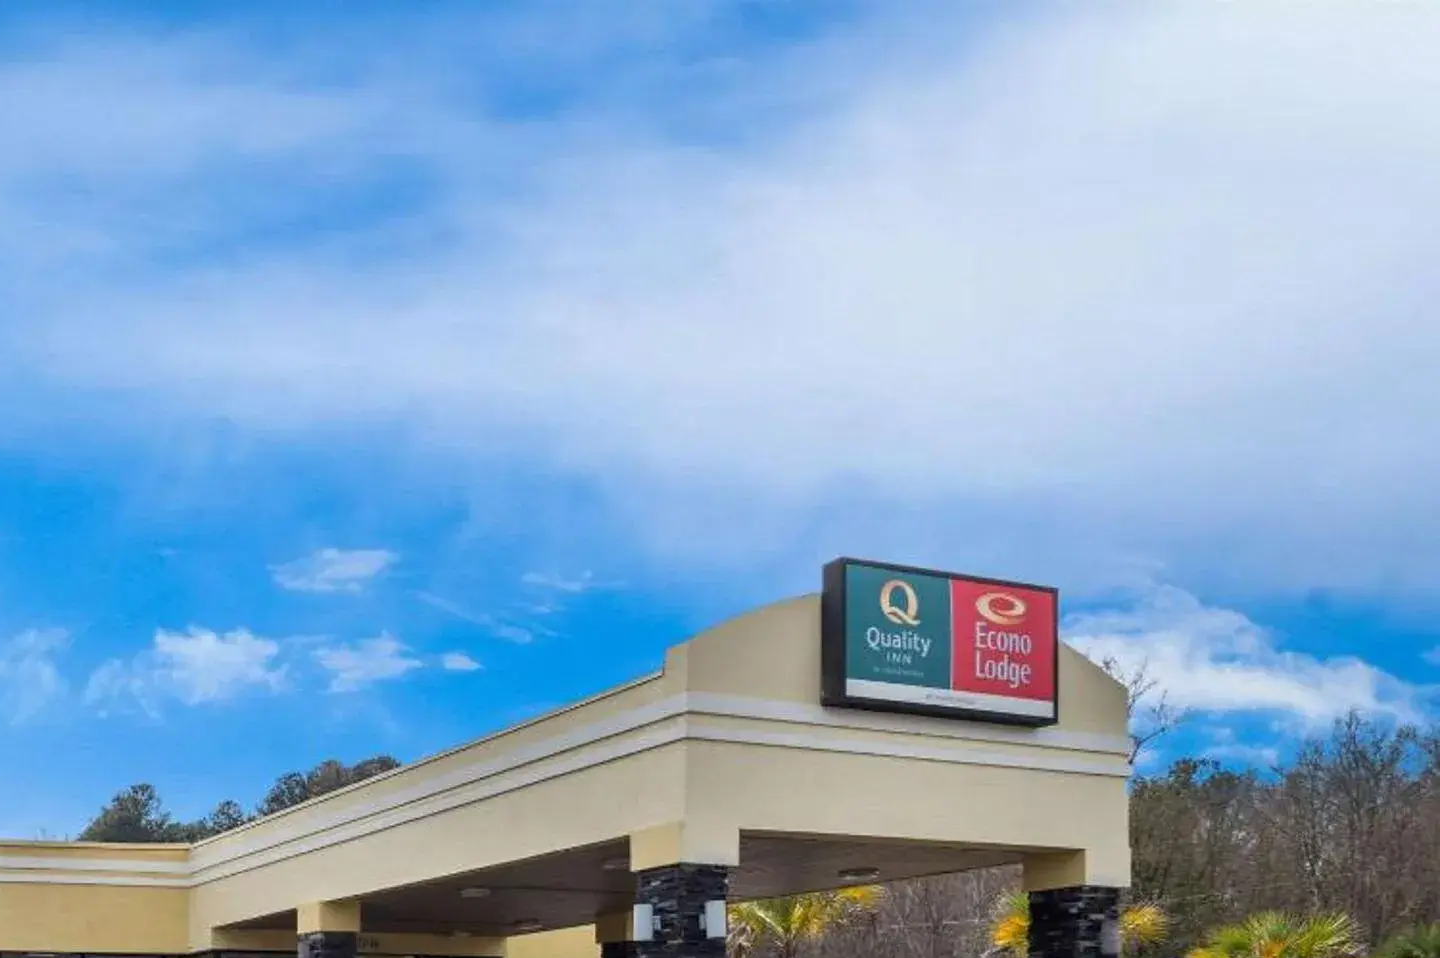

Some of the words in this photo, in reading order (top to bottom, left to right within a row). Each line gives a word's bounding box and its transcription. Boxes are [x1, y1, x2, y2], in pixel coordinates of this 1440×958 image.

[879, 579, 921, 625] Q
[866, 626, 933, 657] Quality
[975, 621, 1032, 656] Econo
[885, 651, 912, 665] INN
[975, 650, 1032, 688] Lodge
